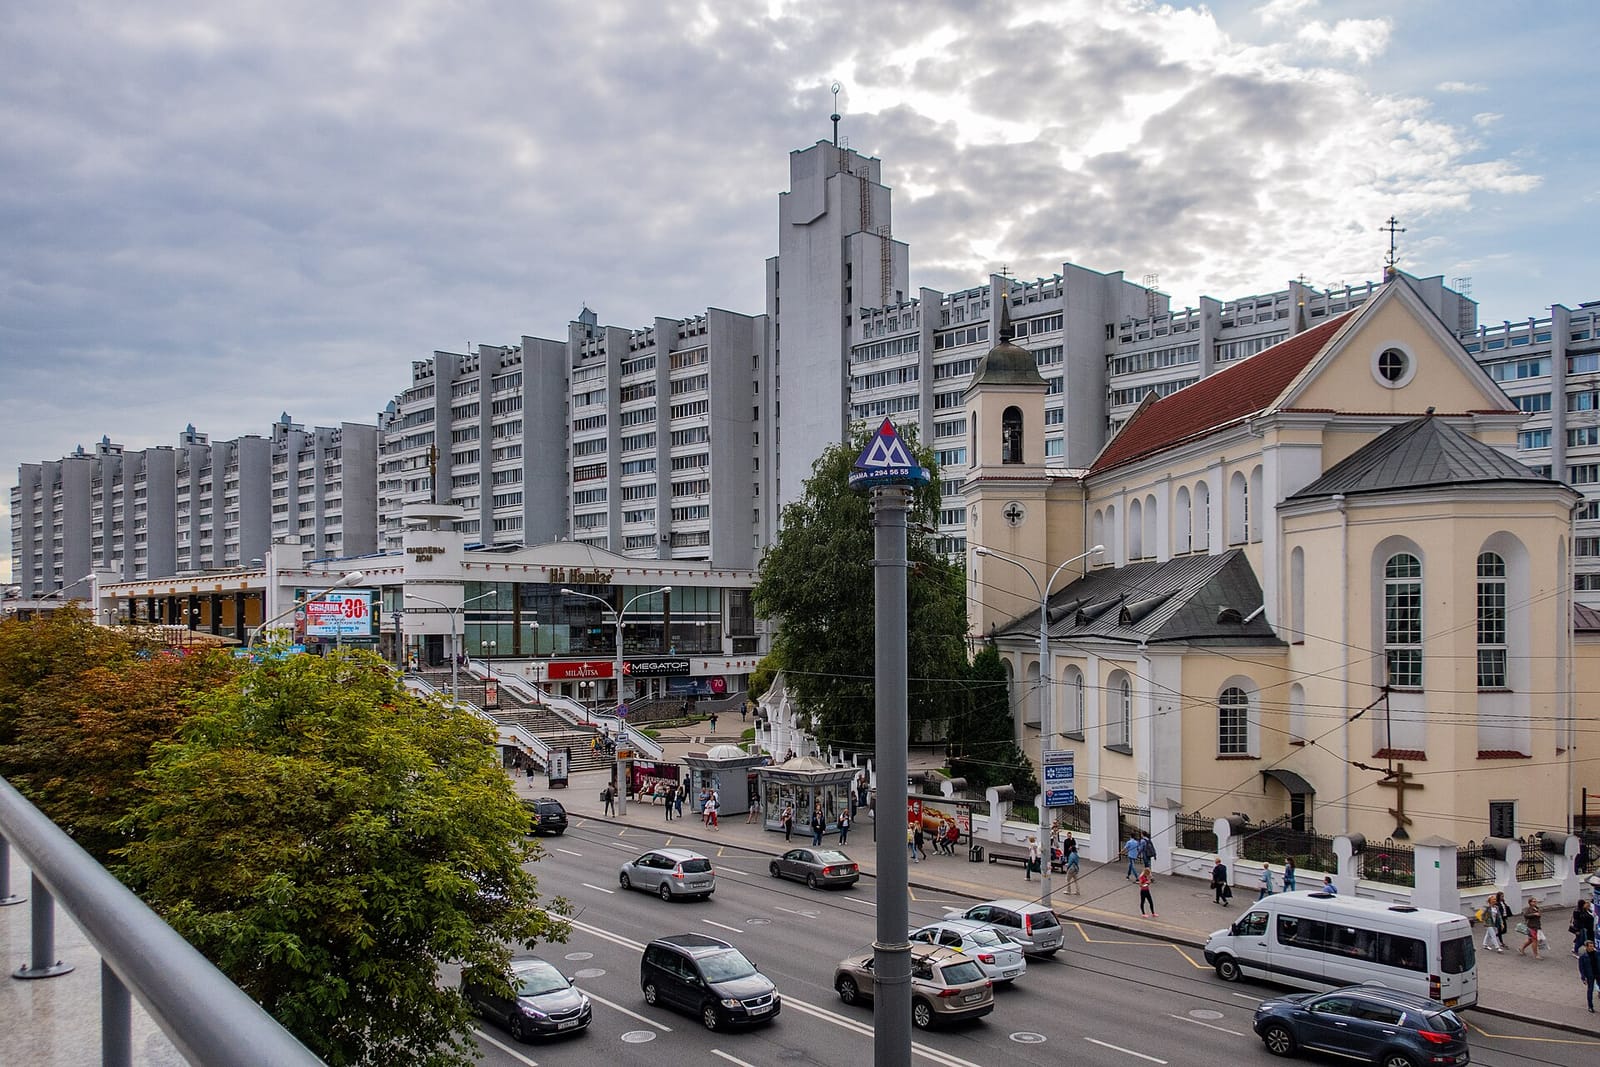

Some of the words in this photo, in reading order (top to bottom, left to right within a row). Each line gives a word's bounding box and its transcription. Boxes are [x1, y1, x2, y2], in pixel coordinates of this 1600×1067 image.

[415, 554, 433, 563] ДОМ
[550, 567, 566, 583] На
[631, 662, 689, 670] MEGATOP
[565, 666, 599, 678] MILAVITSA
[713, 679, 723, 688] 70
